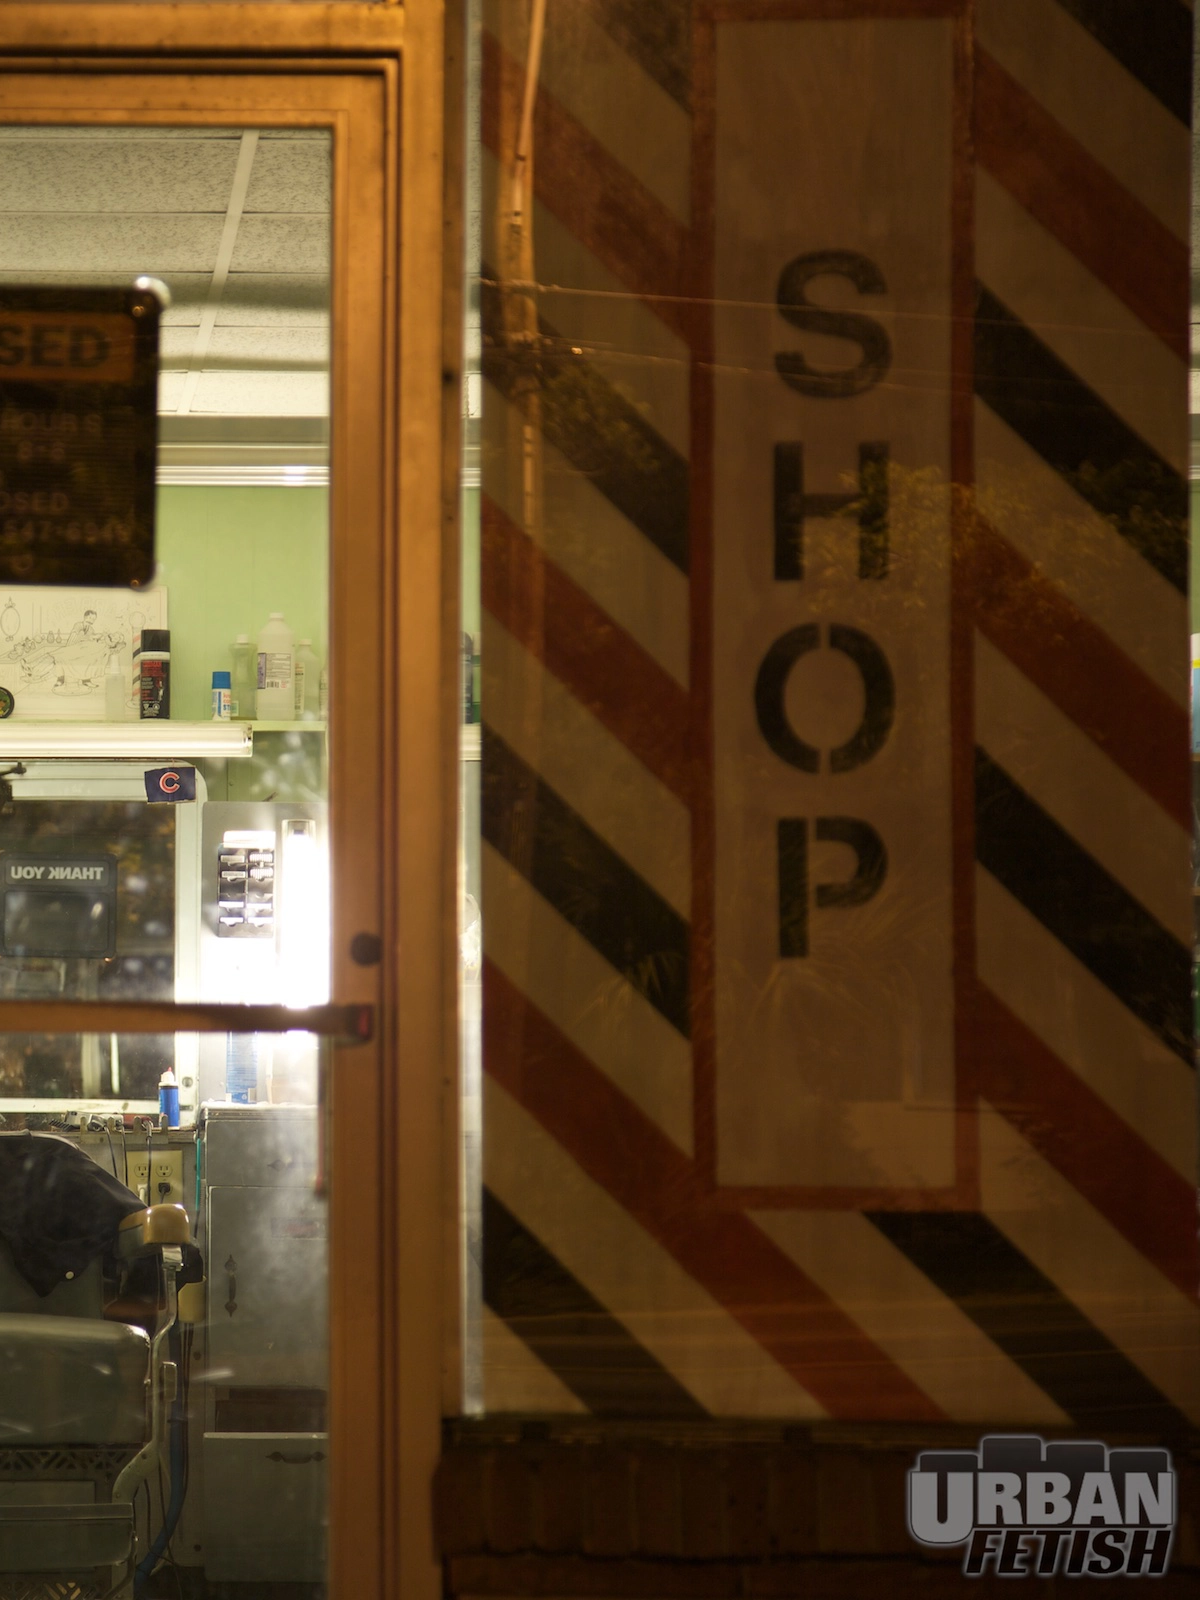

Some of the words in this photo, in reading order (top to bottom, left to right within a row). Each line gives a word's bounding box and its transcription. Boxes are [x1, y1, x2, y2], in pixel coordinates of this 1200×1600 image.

[0, 411, 104, 434] HOURS
[753, 248, 896, 959] SHOP
[159, 771, 180, 794] C
